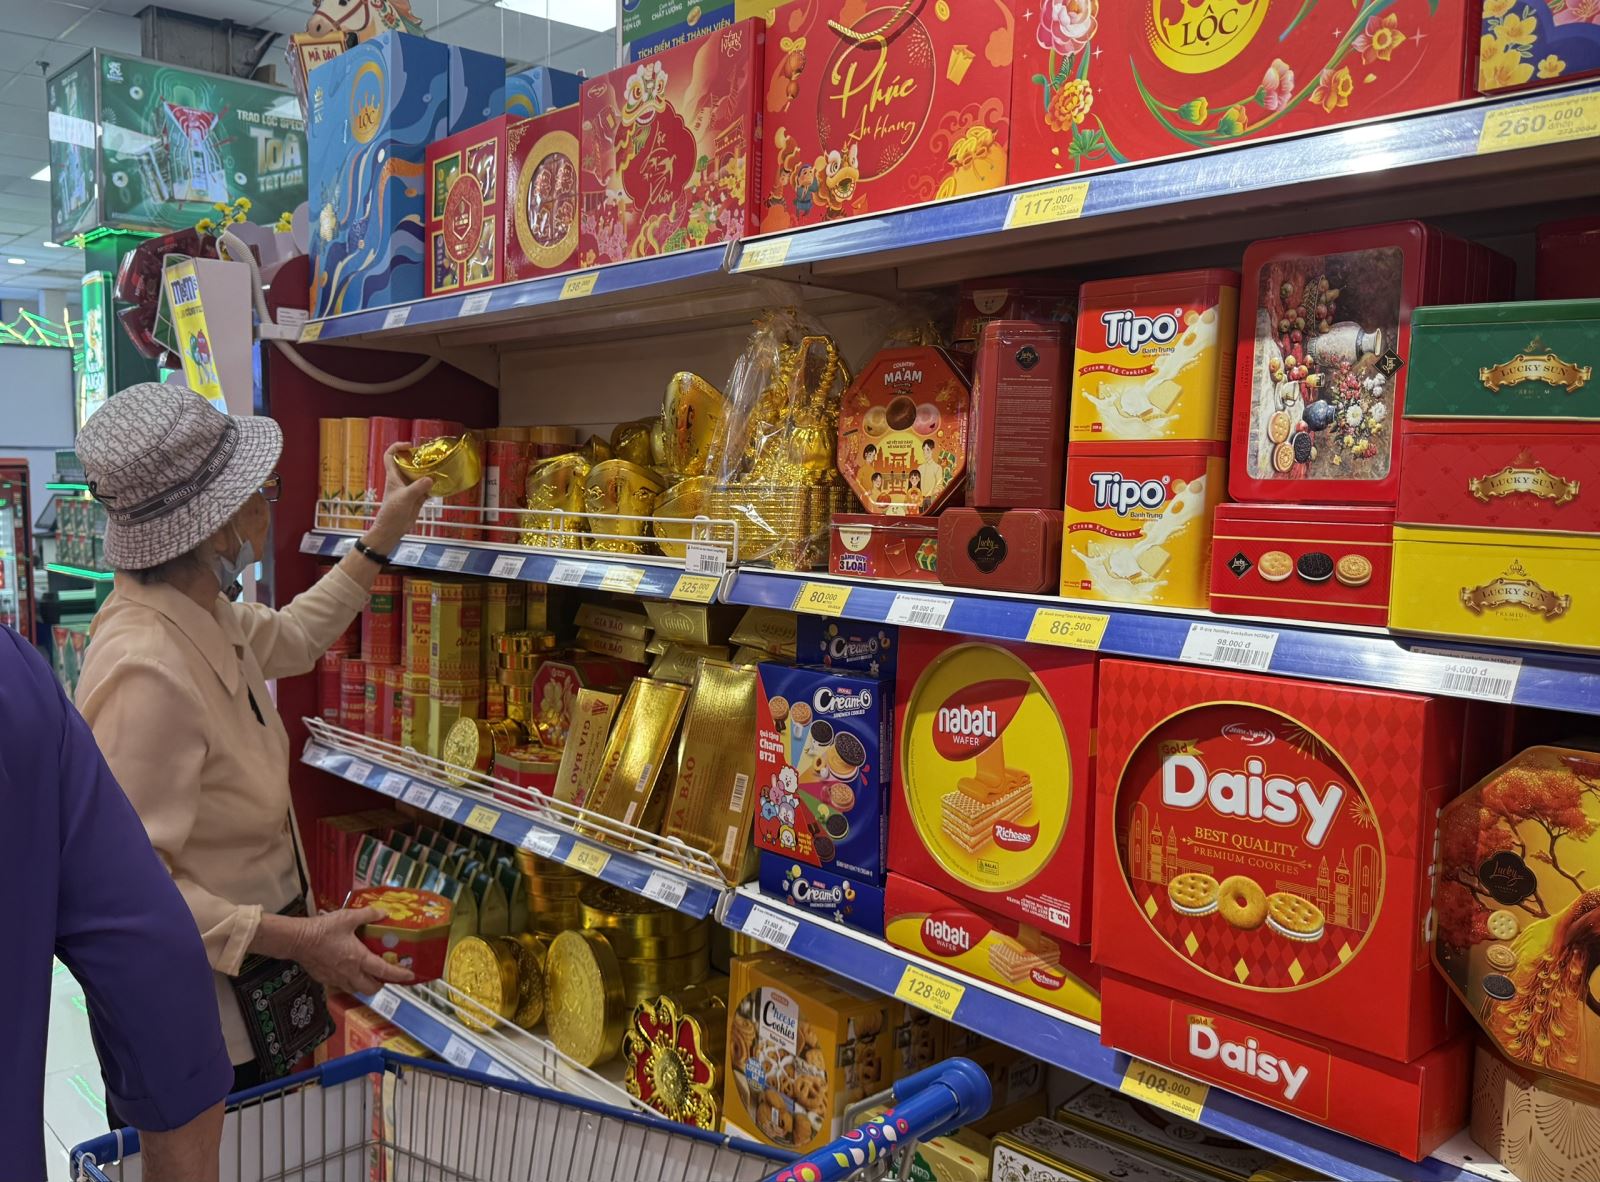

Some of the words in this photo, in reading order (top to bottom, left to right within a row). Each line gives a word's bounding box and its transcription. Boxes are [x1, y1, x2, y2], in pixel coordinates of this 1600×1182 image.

[1180, 4, 1239, 48] LỘC
[1101, 309, 1178, 355] Tipo
[1089, 472, 1166, 518] Tipo
[1050, 620, 1092, 636] 86.500
[938, 704, 997, 738] nabati
[760, 739, 784, 753] Charm
[953, 736, 980, 746] WAFER
[1162, 755, 1344, 847] Daisy
[1195, 827, 1229, 843] BEST
[1231, 832, 1299, 858] QUALITY
[1194, 847, 1245, 865] PREMIUM
[1248, 859, 1299, 877] COOKIES
[924, 914, 970, 950] nabati
[908, 978, 951, 1001] 128.000
[1186, 1022, 1309, 1101] Daisy
[1137, 1070, 1191, 1096] 108.000
